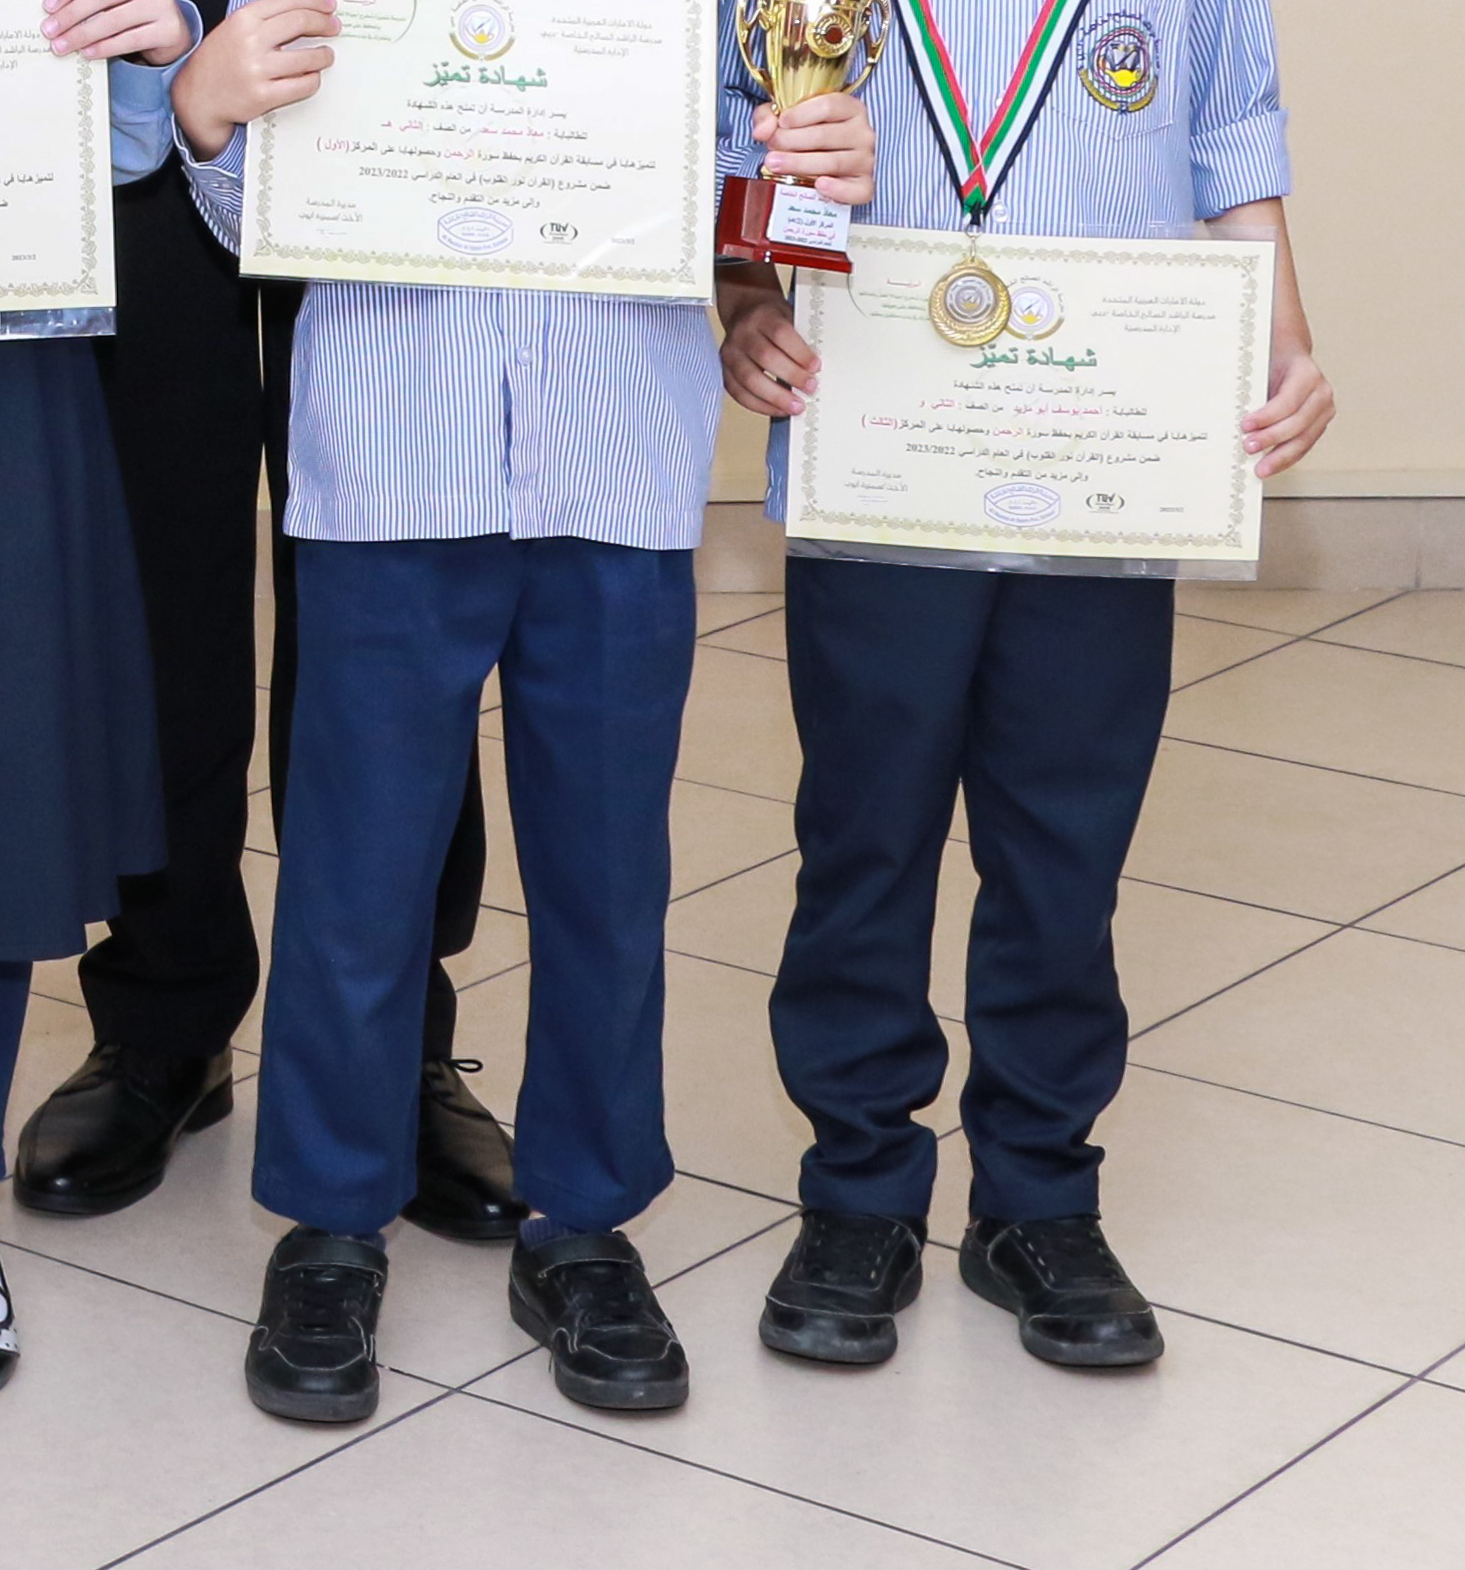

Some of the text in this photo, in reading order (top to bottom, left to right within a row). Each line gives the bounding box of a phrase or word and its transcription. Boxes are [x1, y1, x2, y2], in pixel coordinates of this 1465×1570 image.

[432, 123, 457, 132] الصف
[459, 126, 472, 139] من
[358, 165, 409, 180] 2023/2022
[3, 173, 15, 187] في
[557, 179, 587, 192] مشروع
[486, 195, 500, 206] من
[964, 401, 989, 411] الصف
[991, 404, 1004, 414] من
[905, 442, 956, 456] 2023/2022
[1106, 453, 1137, 465] مشروع
[1034, 471, 1048, 481] من
